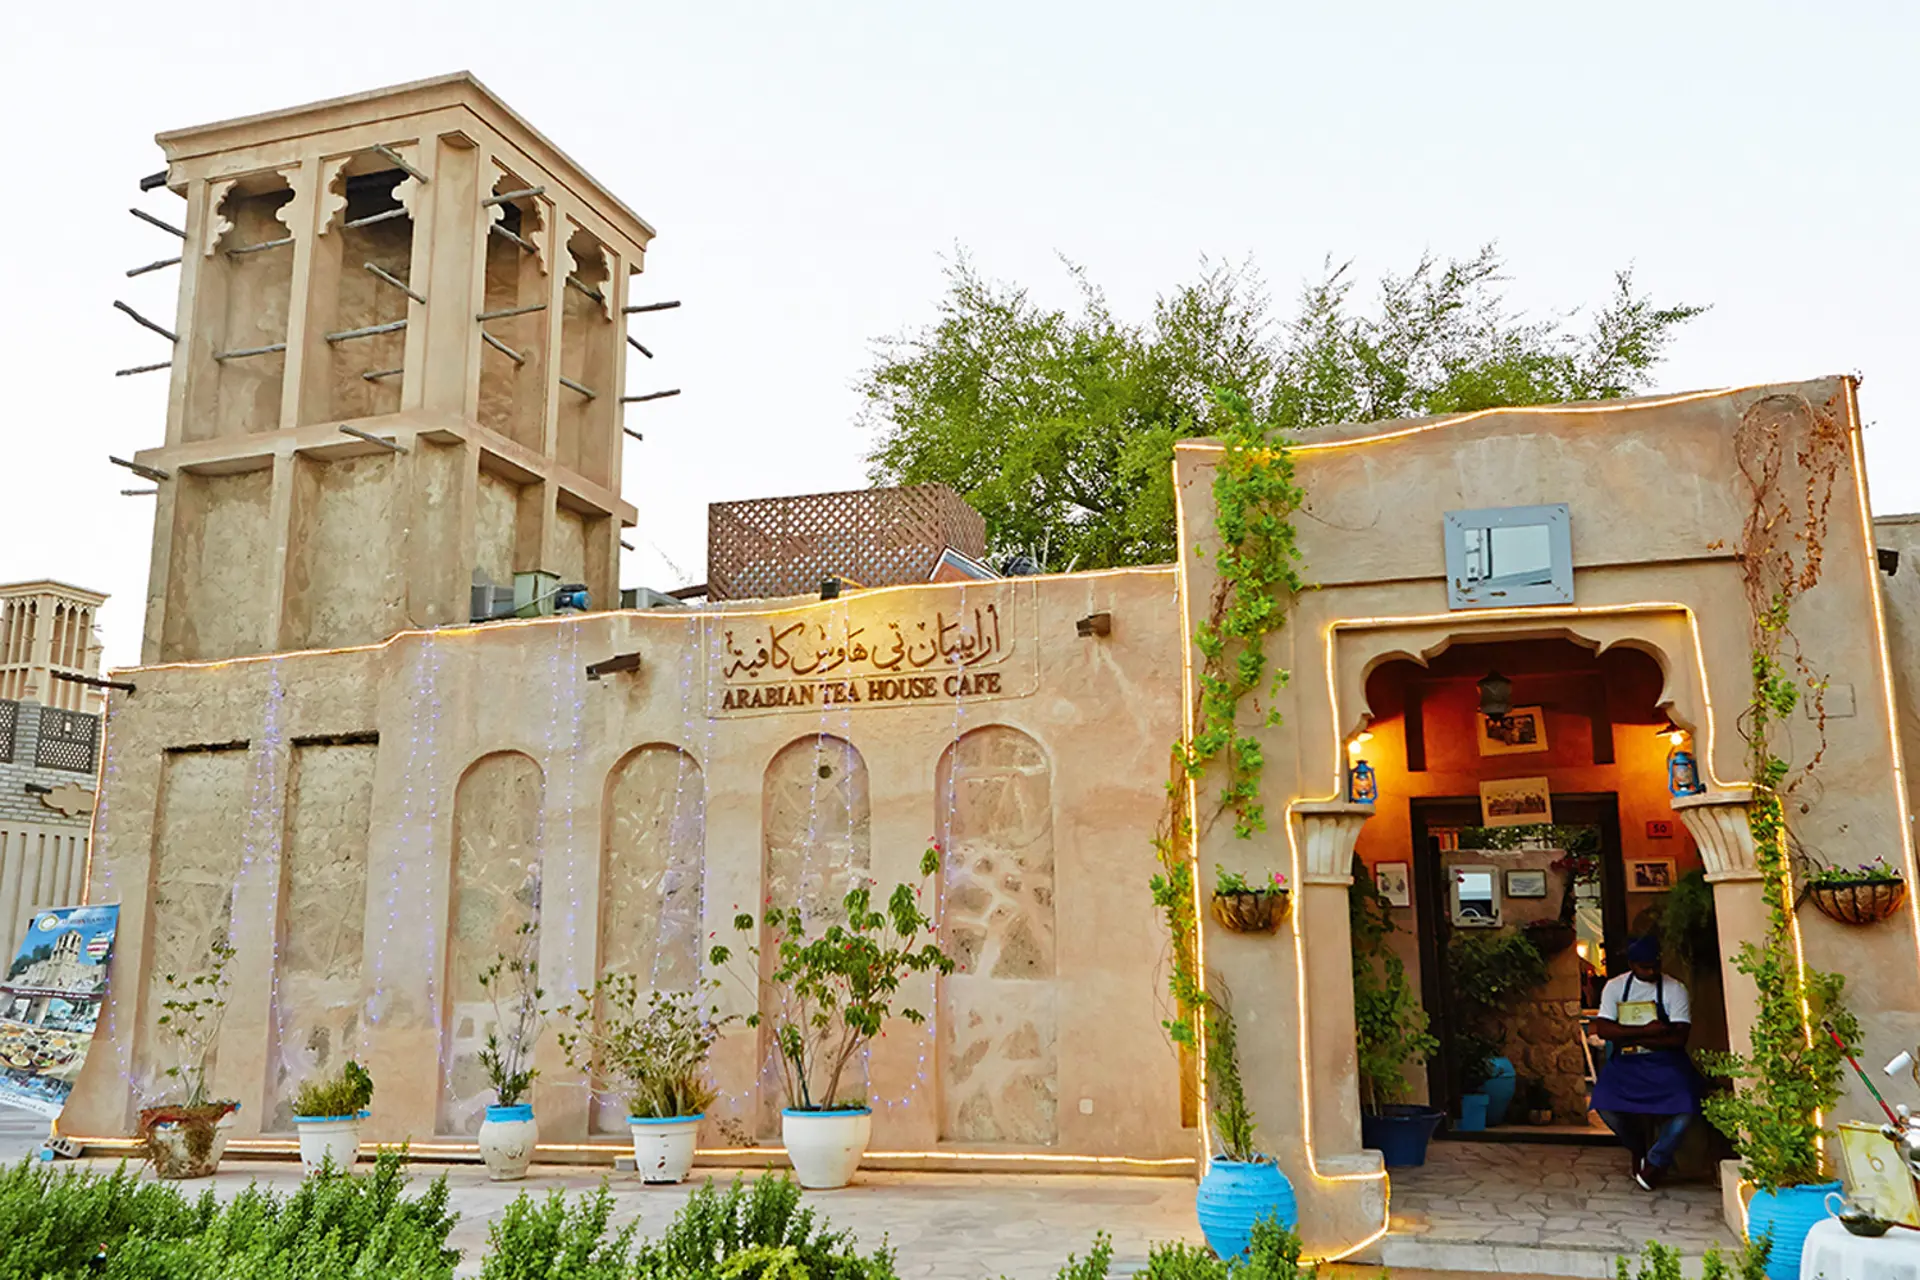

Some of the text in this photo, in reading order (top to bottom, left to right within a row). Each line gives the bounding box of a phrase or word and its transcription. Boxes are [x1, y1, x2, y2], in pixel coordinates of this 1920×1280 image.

[722, 672, 1002, 709] ARABIAN TEA HOUSE CAFE
